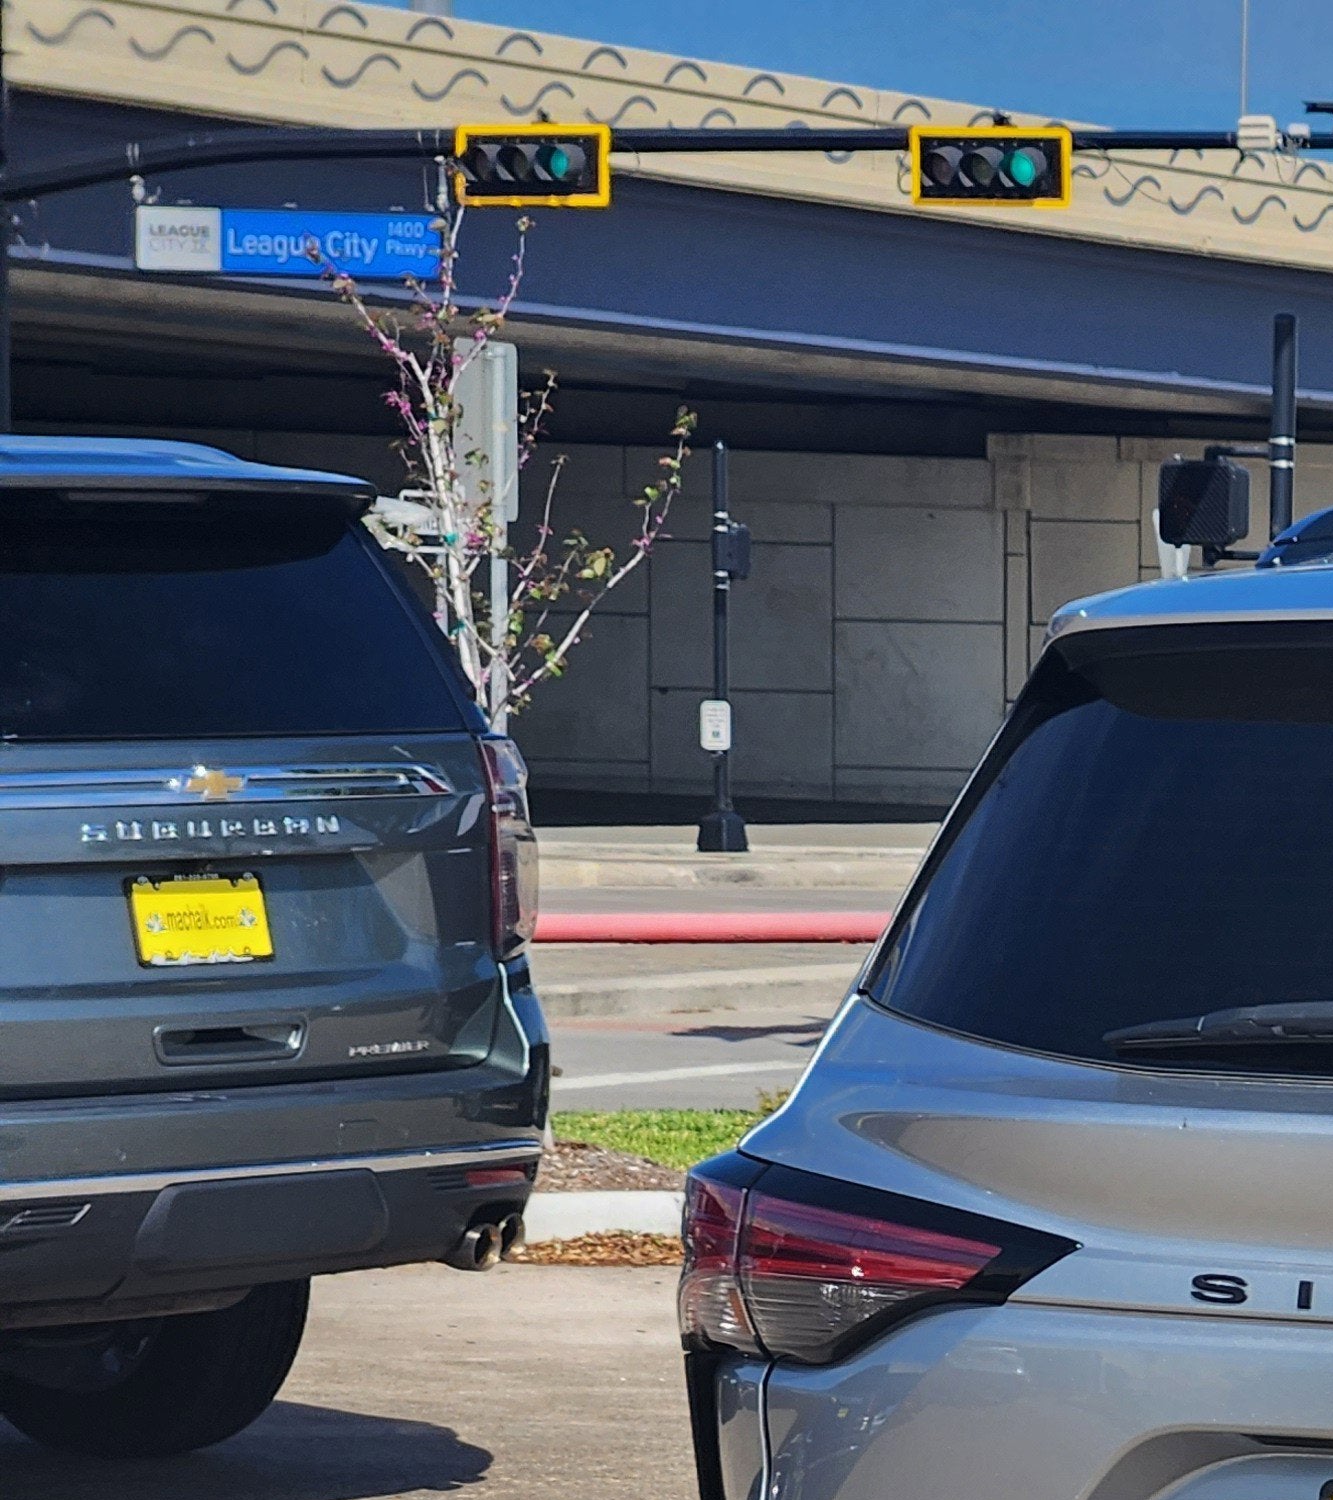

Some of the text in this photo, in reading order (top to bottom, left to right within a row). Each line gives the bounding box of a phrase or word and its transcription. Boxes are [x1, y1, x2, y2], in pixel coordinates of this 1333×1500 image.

[149, 224, 210, 238] LEAGUE
[387, 221, 425, 238] 1400
[227, 228, 379, 264] League City
[80, 814, 341, 843] SUBURBAN
